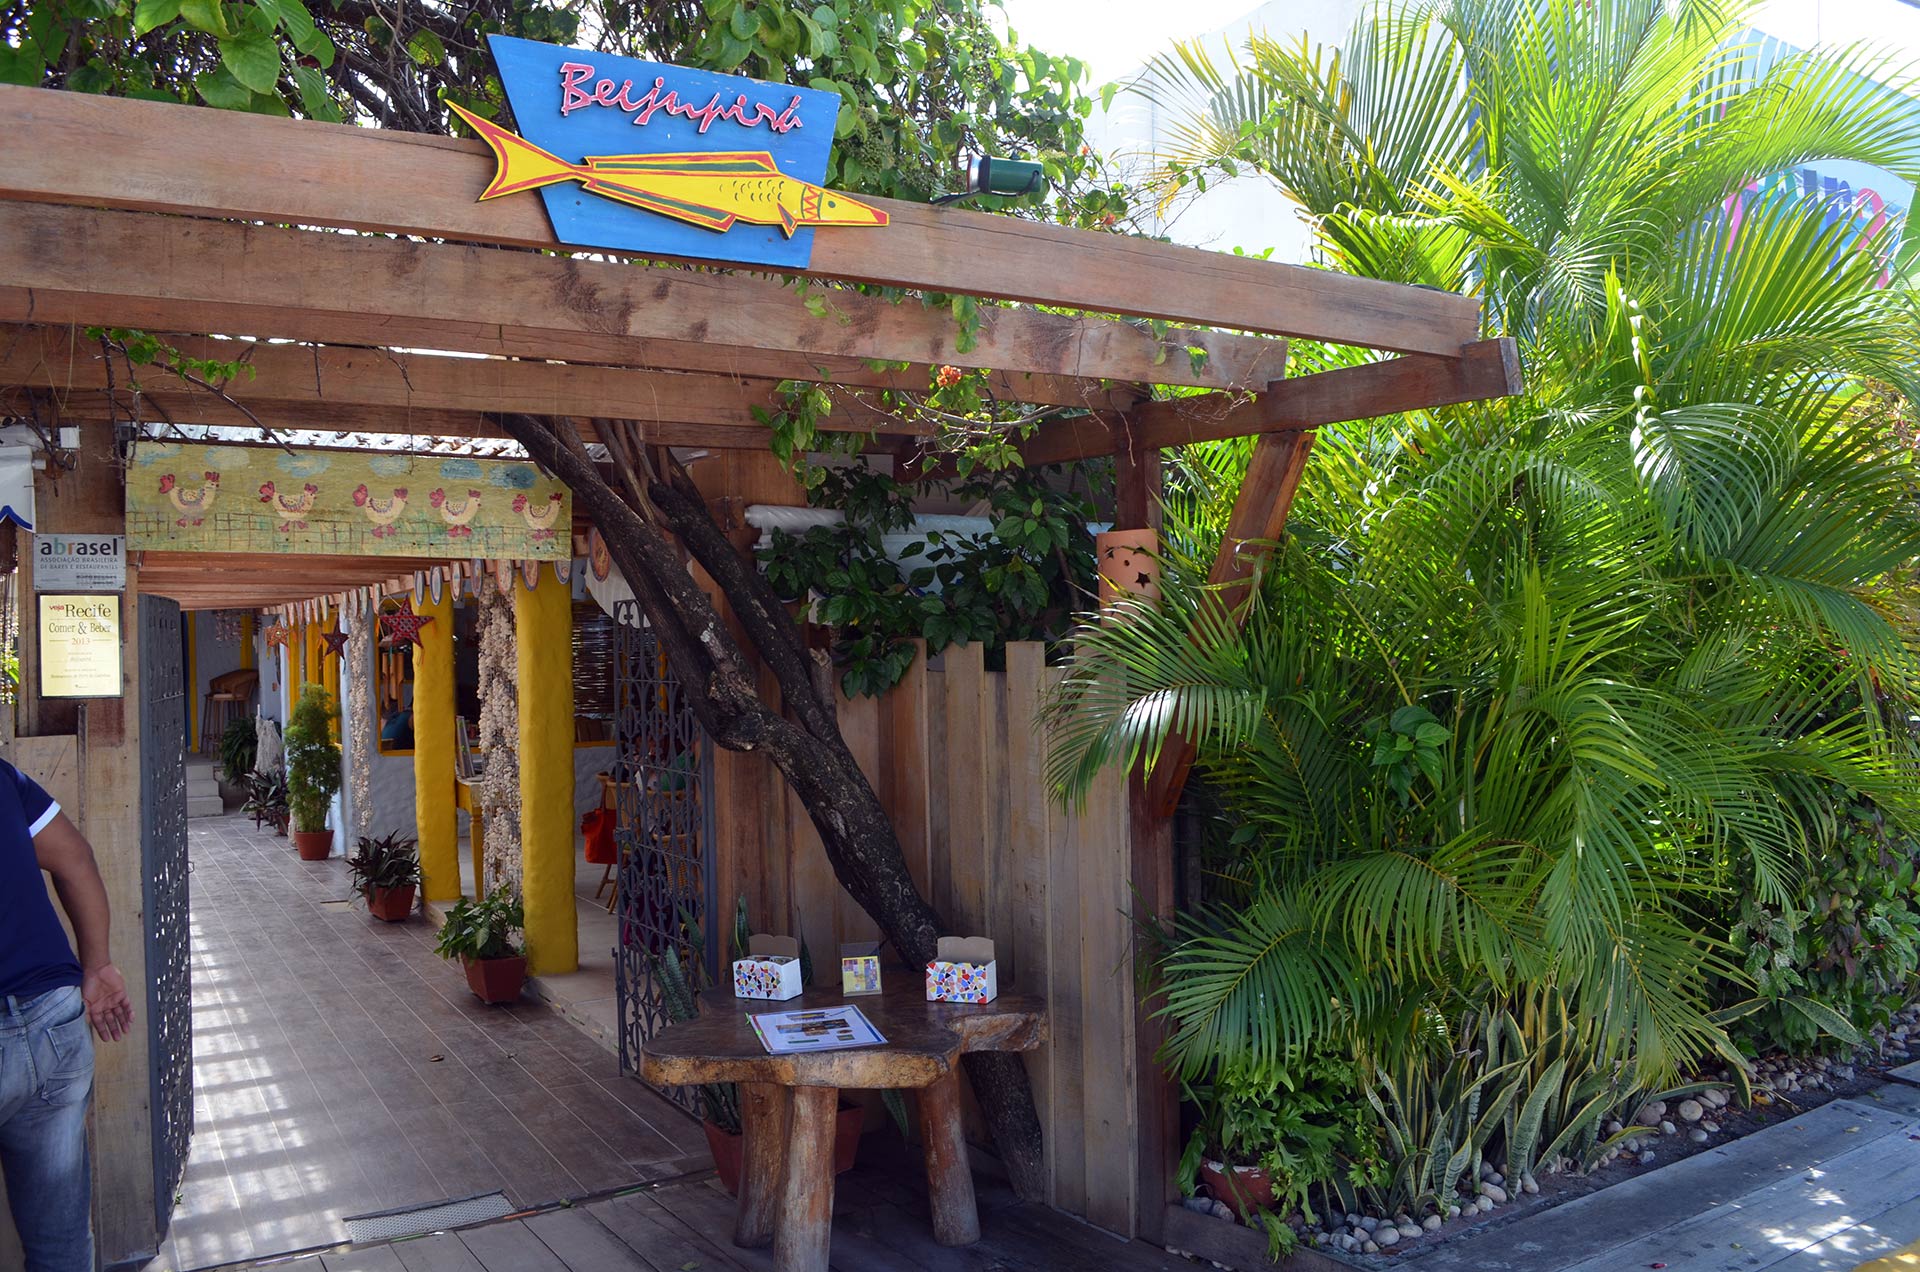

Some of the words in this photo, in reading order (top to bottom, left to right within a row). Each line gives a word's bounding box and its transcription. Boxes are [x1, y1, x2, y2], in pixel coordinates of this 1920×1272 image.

[560, 62, 804, 134] Beijupirá
[40, 537, 118, 555] abrasel
[65, 603, 112, 617] Recife
[48, 622, 76, 633] Comer
[77, 621, 87, 635] &
[90, 622, 111, 633] Beber
